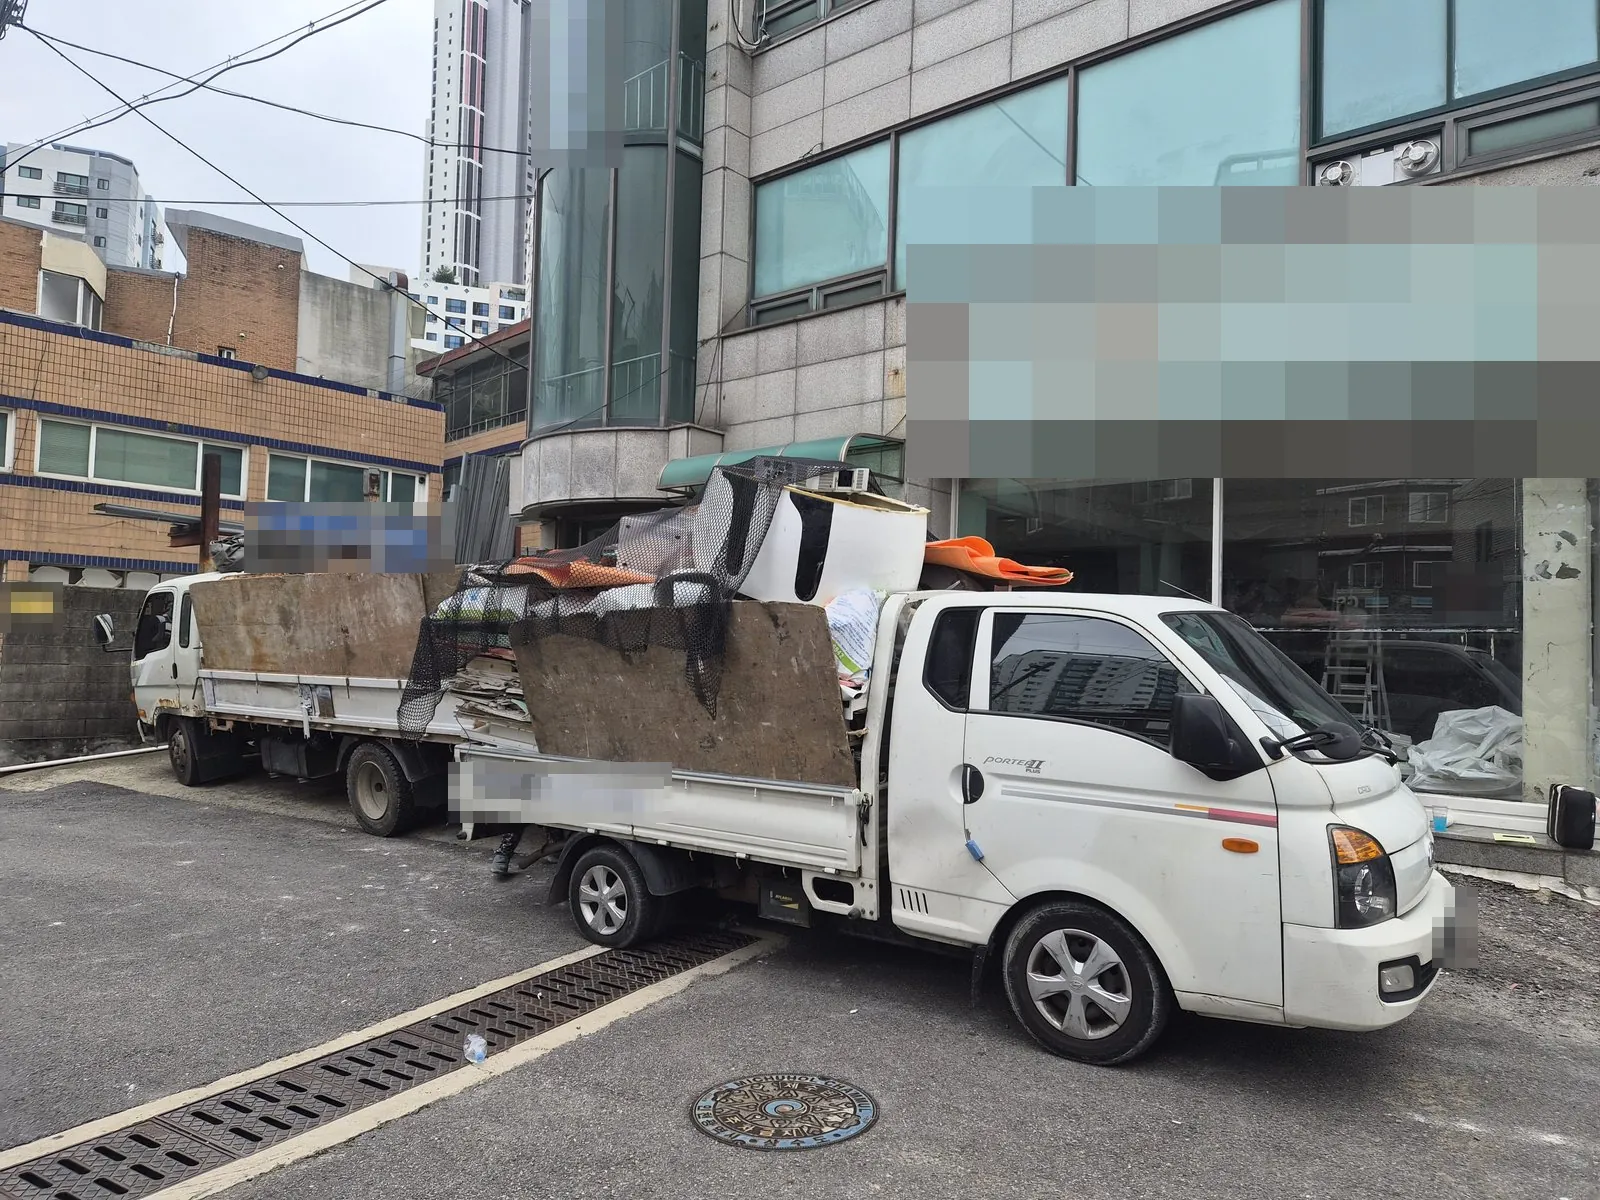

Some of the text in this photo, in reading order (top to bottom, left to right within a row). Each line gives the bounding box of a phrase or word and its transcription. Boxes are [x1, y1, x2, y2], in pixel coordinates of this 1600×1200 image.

[983, 756, 1034, 767] PORTER
[733, 1075, 817, 1087] MICHUHOL
[697, 1105, 829, 1147] 인천광역시 상수도
